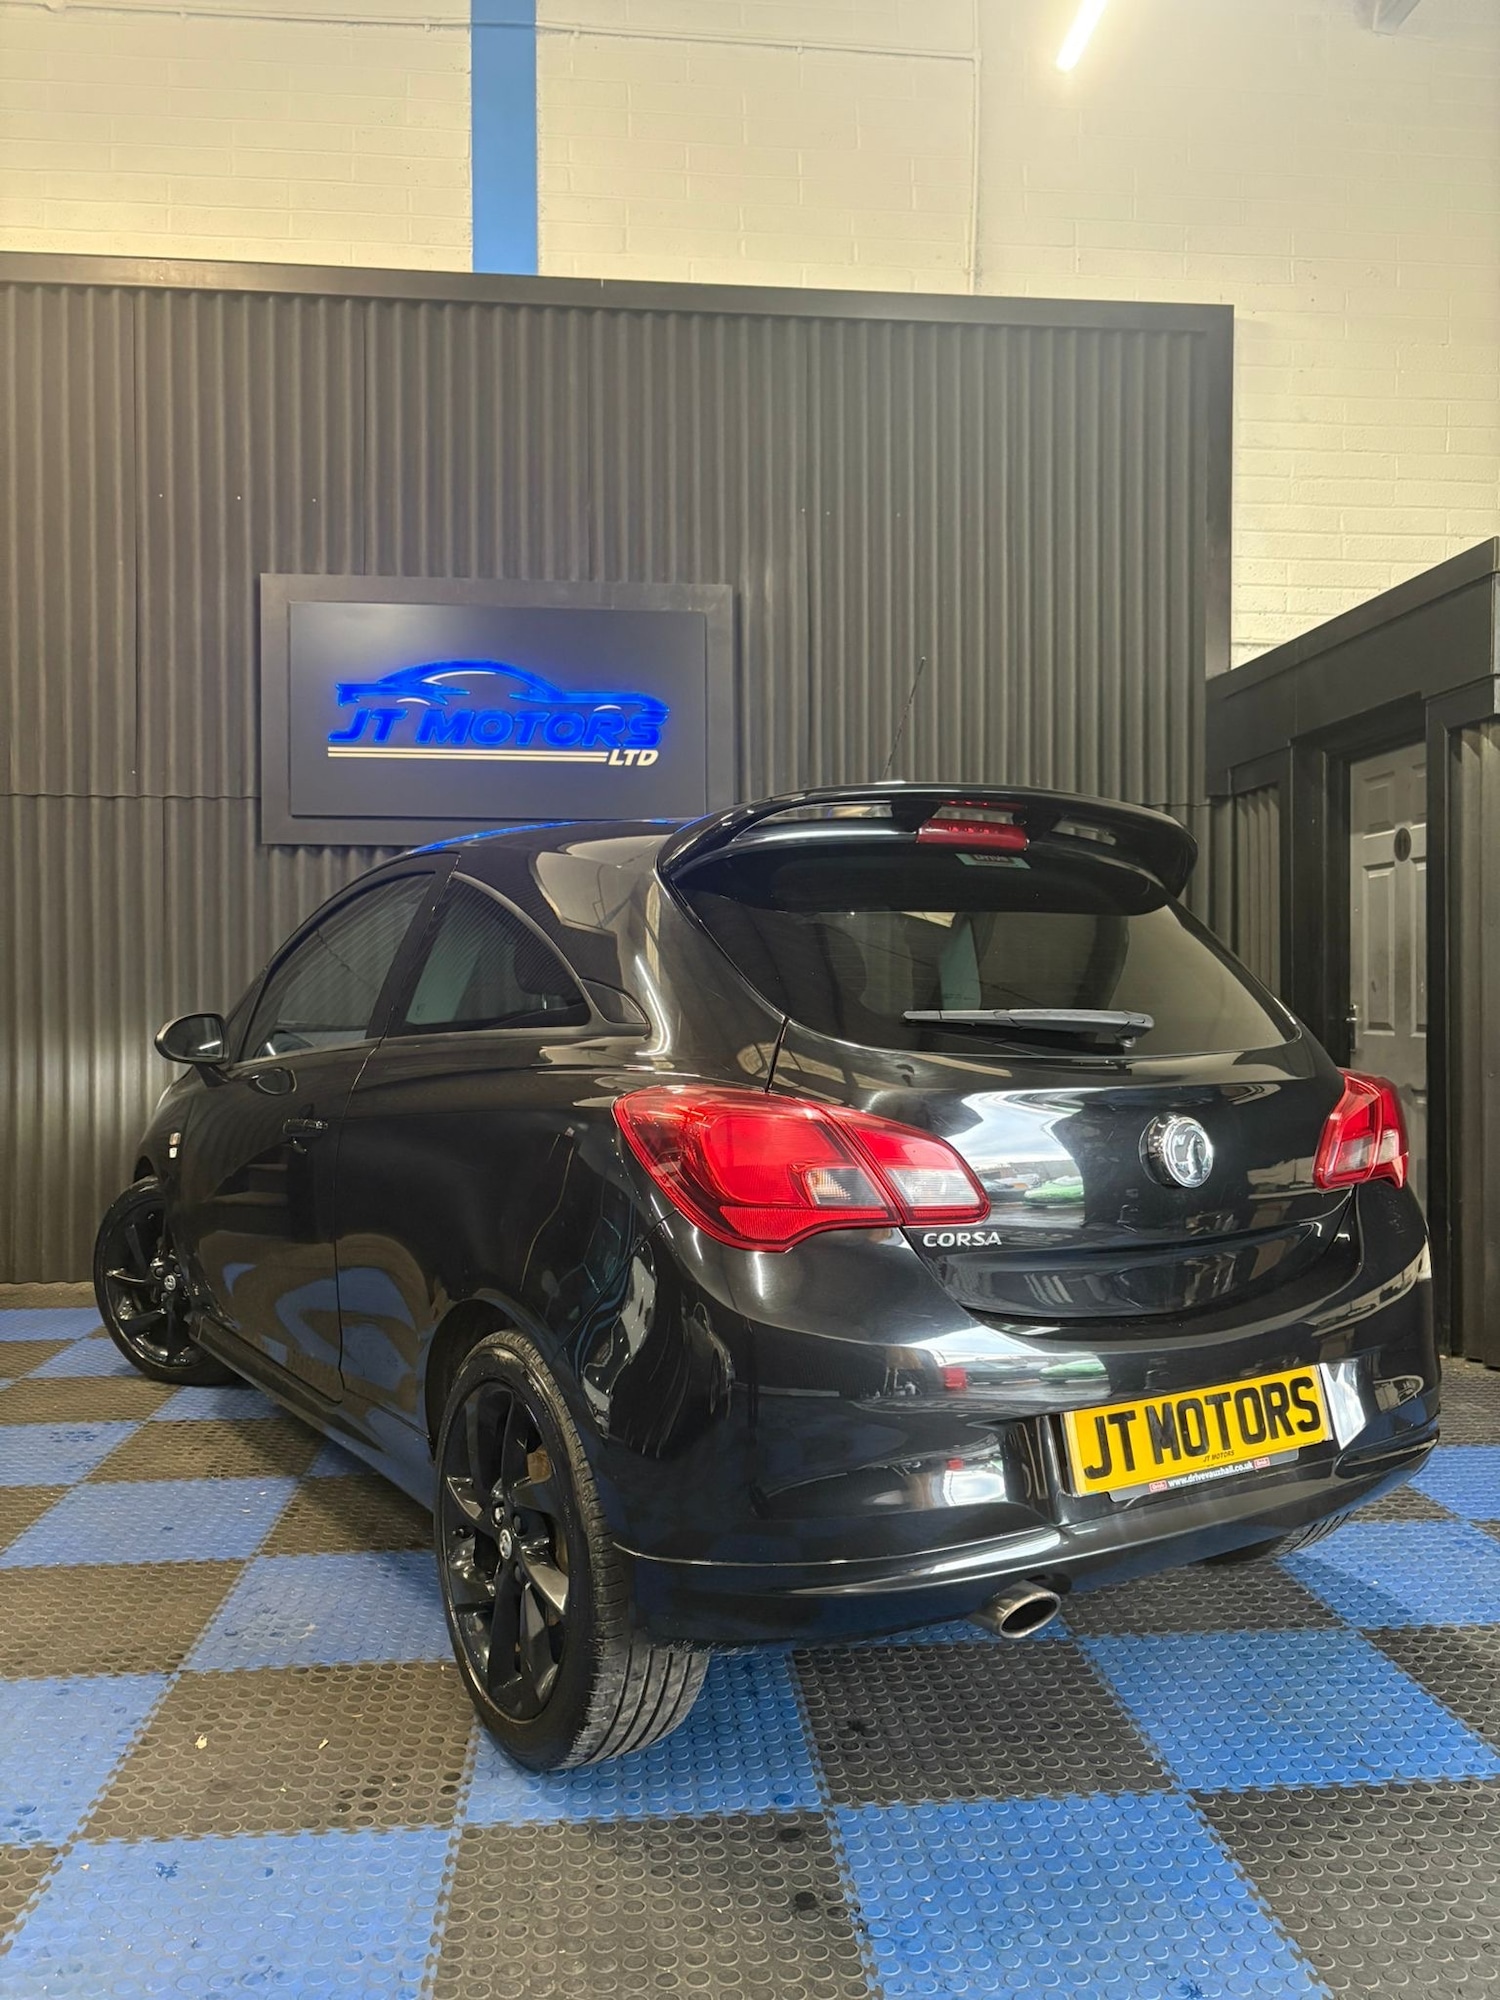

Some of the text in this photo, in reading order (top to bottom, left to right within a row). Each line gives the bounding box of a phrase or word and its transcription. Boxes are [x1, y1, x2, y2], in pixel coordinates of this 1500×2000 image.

[328, 708, 669, 748] JT MOTORS
[608, 749, 659, 766] LTD
[922, 1231, 1002, 1247] CORSA
[1084, 1376, 1321, 1480] JT MOTORS
[1203, 1450, 1235, 1462] JT MOTORS
[1168, 1460, 1254, 1488] www.drivevauxhall.co.uk
